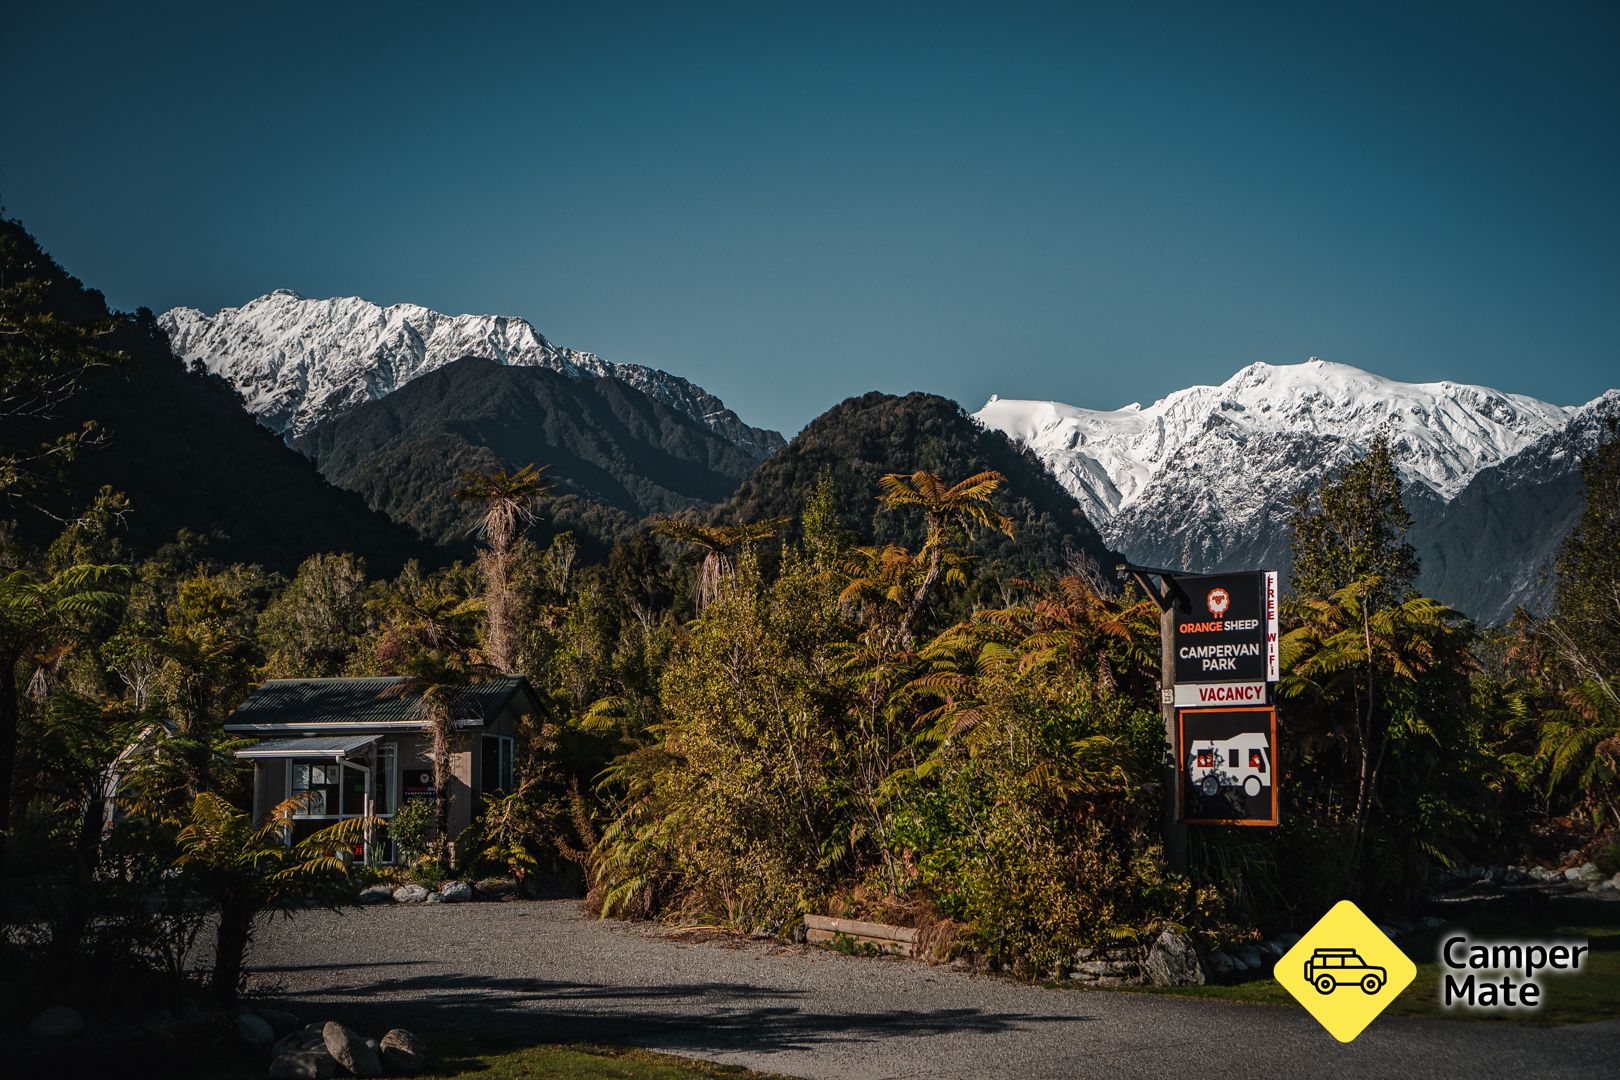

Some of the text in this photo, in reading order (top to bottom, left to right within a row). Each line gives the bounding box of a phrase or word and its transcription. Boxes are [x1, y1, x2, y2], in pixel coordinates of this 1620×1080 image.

[1267, 575, 1275, 620] FREE
[1180, 619, 1259, 633] ORANGE SHEEP
[1180, 643, 1259, 659] CAMPERVAN
[1202, 658, 1236, 671] PARK
[1199, 685, 1263, 701] VACANCY
